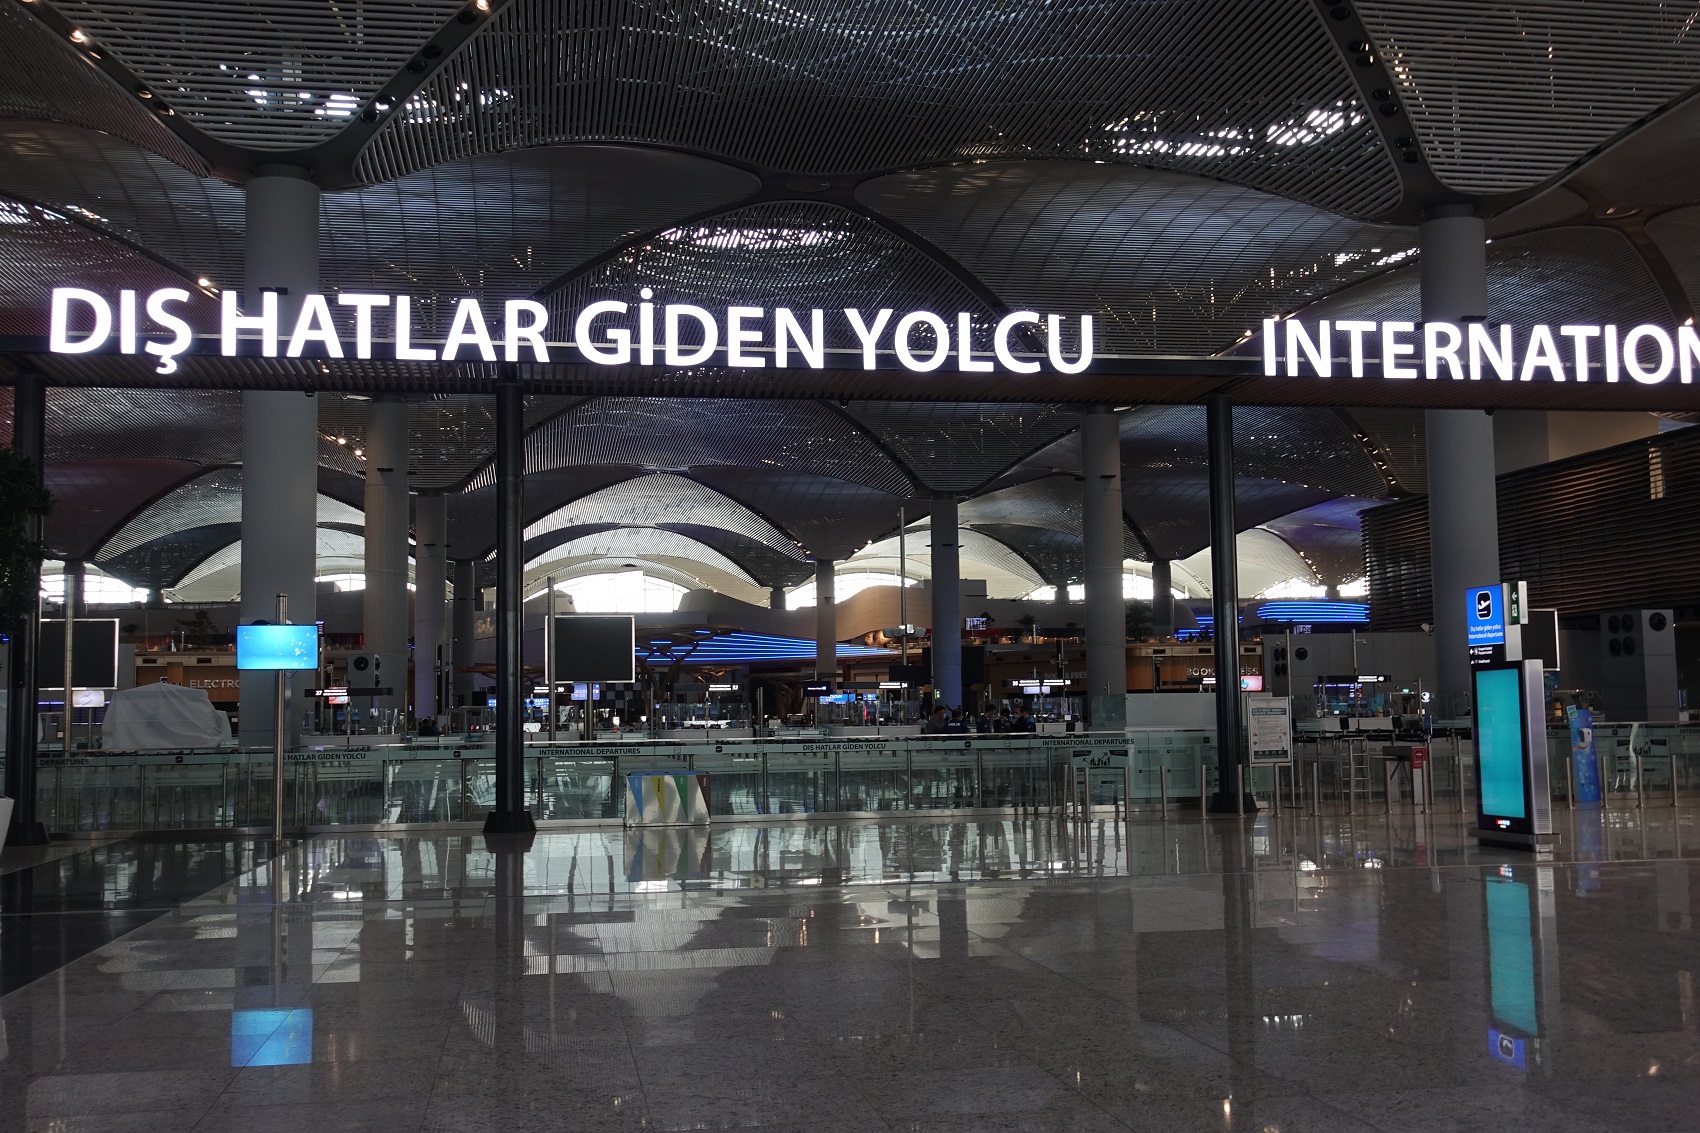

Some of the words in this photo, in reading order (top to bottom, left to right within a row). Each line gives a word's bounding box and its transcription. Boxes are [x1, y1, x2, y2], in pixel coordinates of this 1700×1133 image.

[50, 286, 192, 375] DIŞ
[221, 290, 550, 363] HATLAR
[574, 287, 824, 369] GİDEN
[843, 308, 1094, 375] YOLCU
[317, 752, 341, 760] GİDEN
[539, 748, 595, 756] INTERNATIONAL
[40, 758, 90, 766] DEPARTURES
